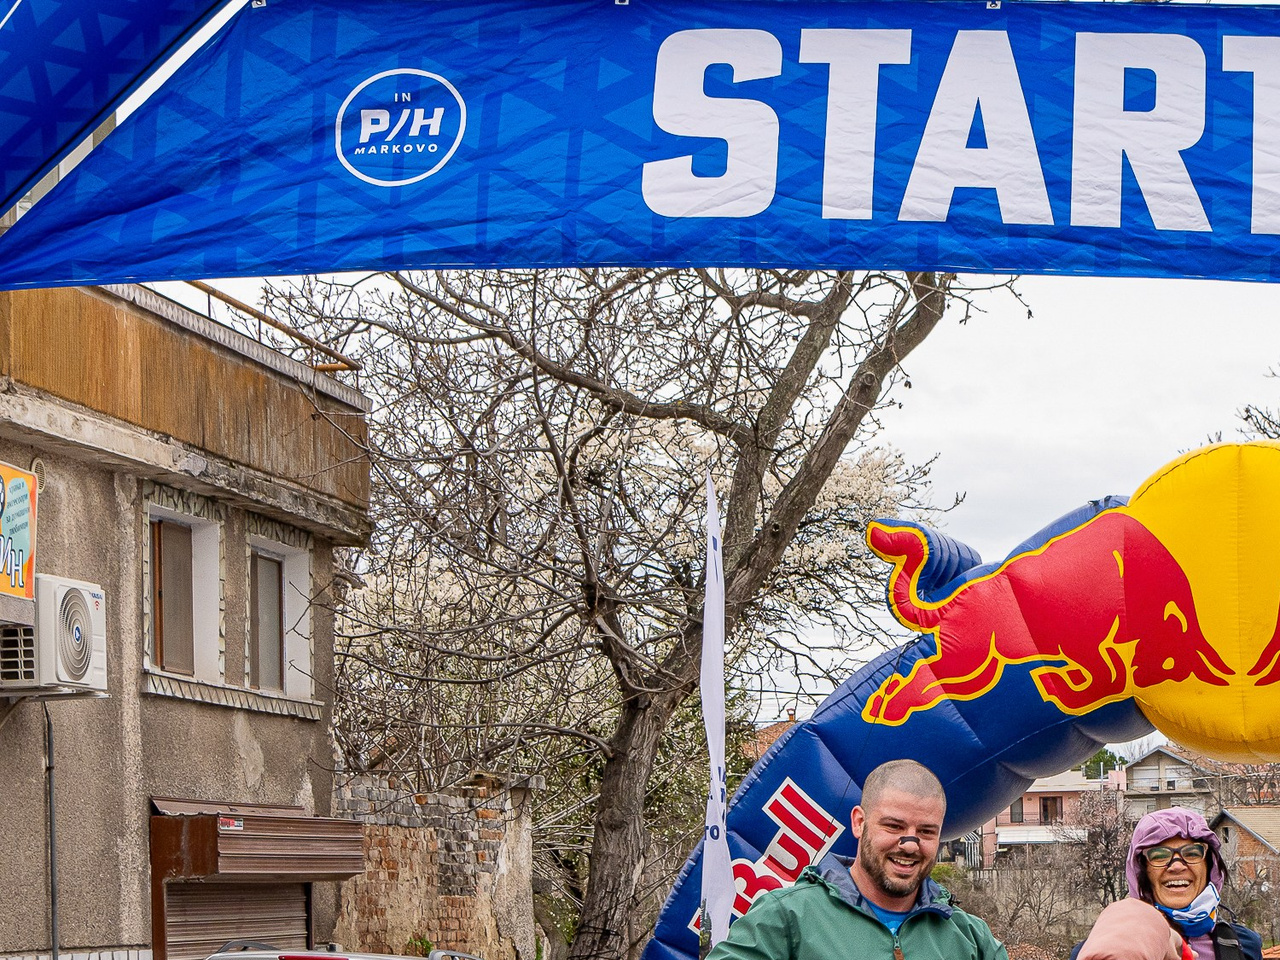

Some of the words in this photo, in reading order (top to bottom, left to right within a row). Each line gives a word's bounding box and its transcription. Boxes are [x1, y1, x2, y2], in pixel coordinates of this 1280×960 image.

[394, 92, 411, 102] IN
[358, 107, 445, 143] P/H
[354, 143, 438, 155] MARKOVO
